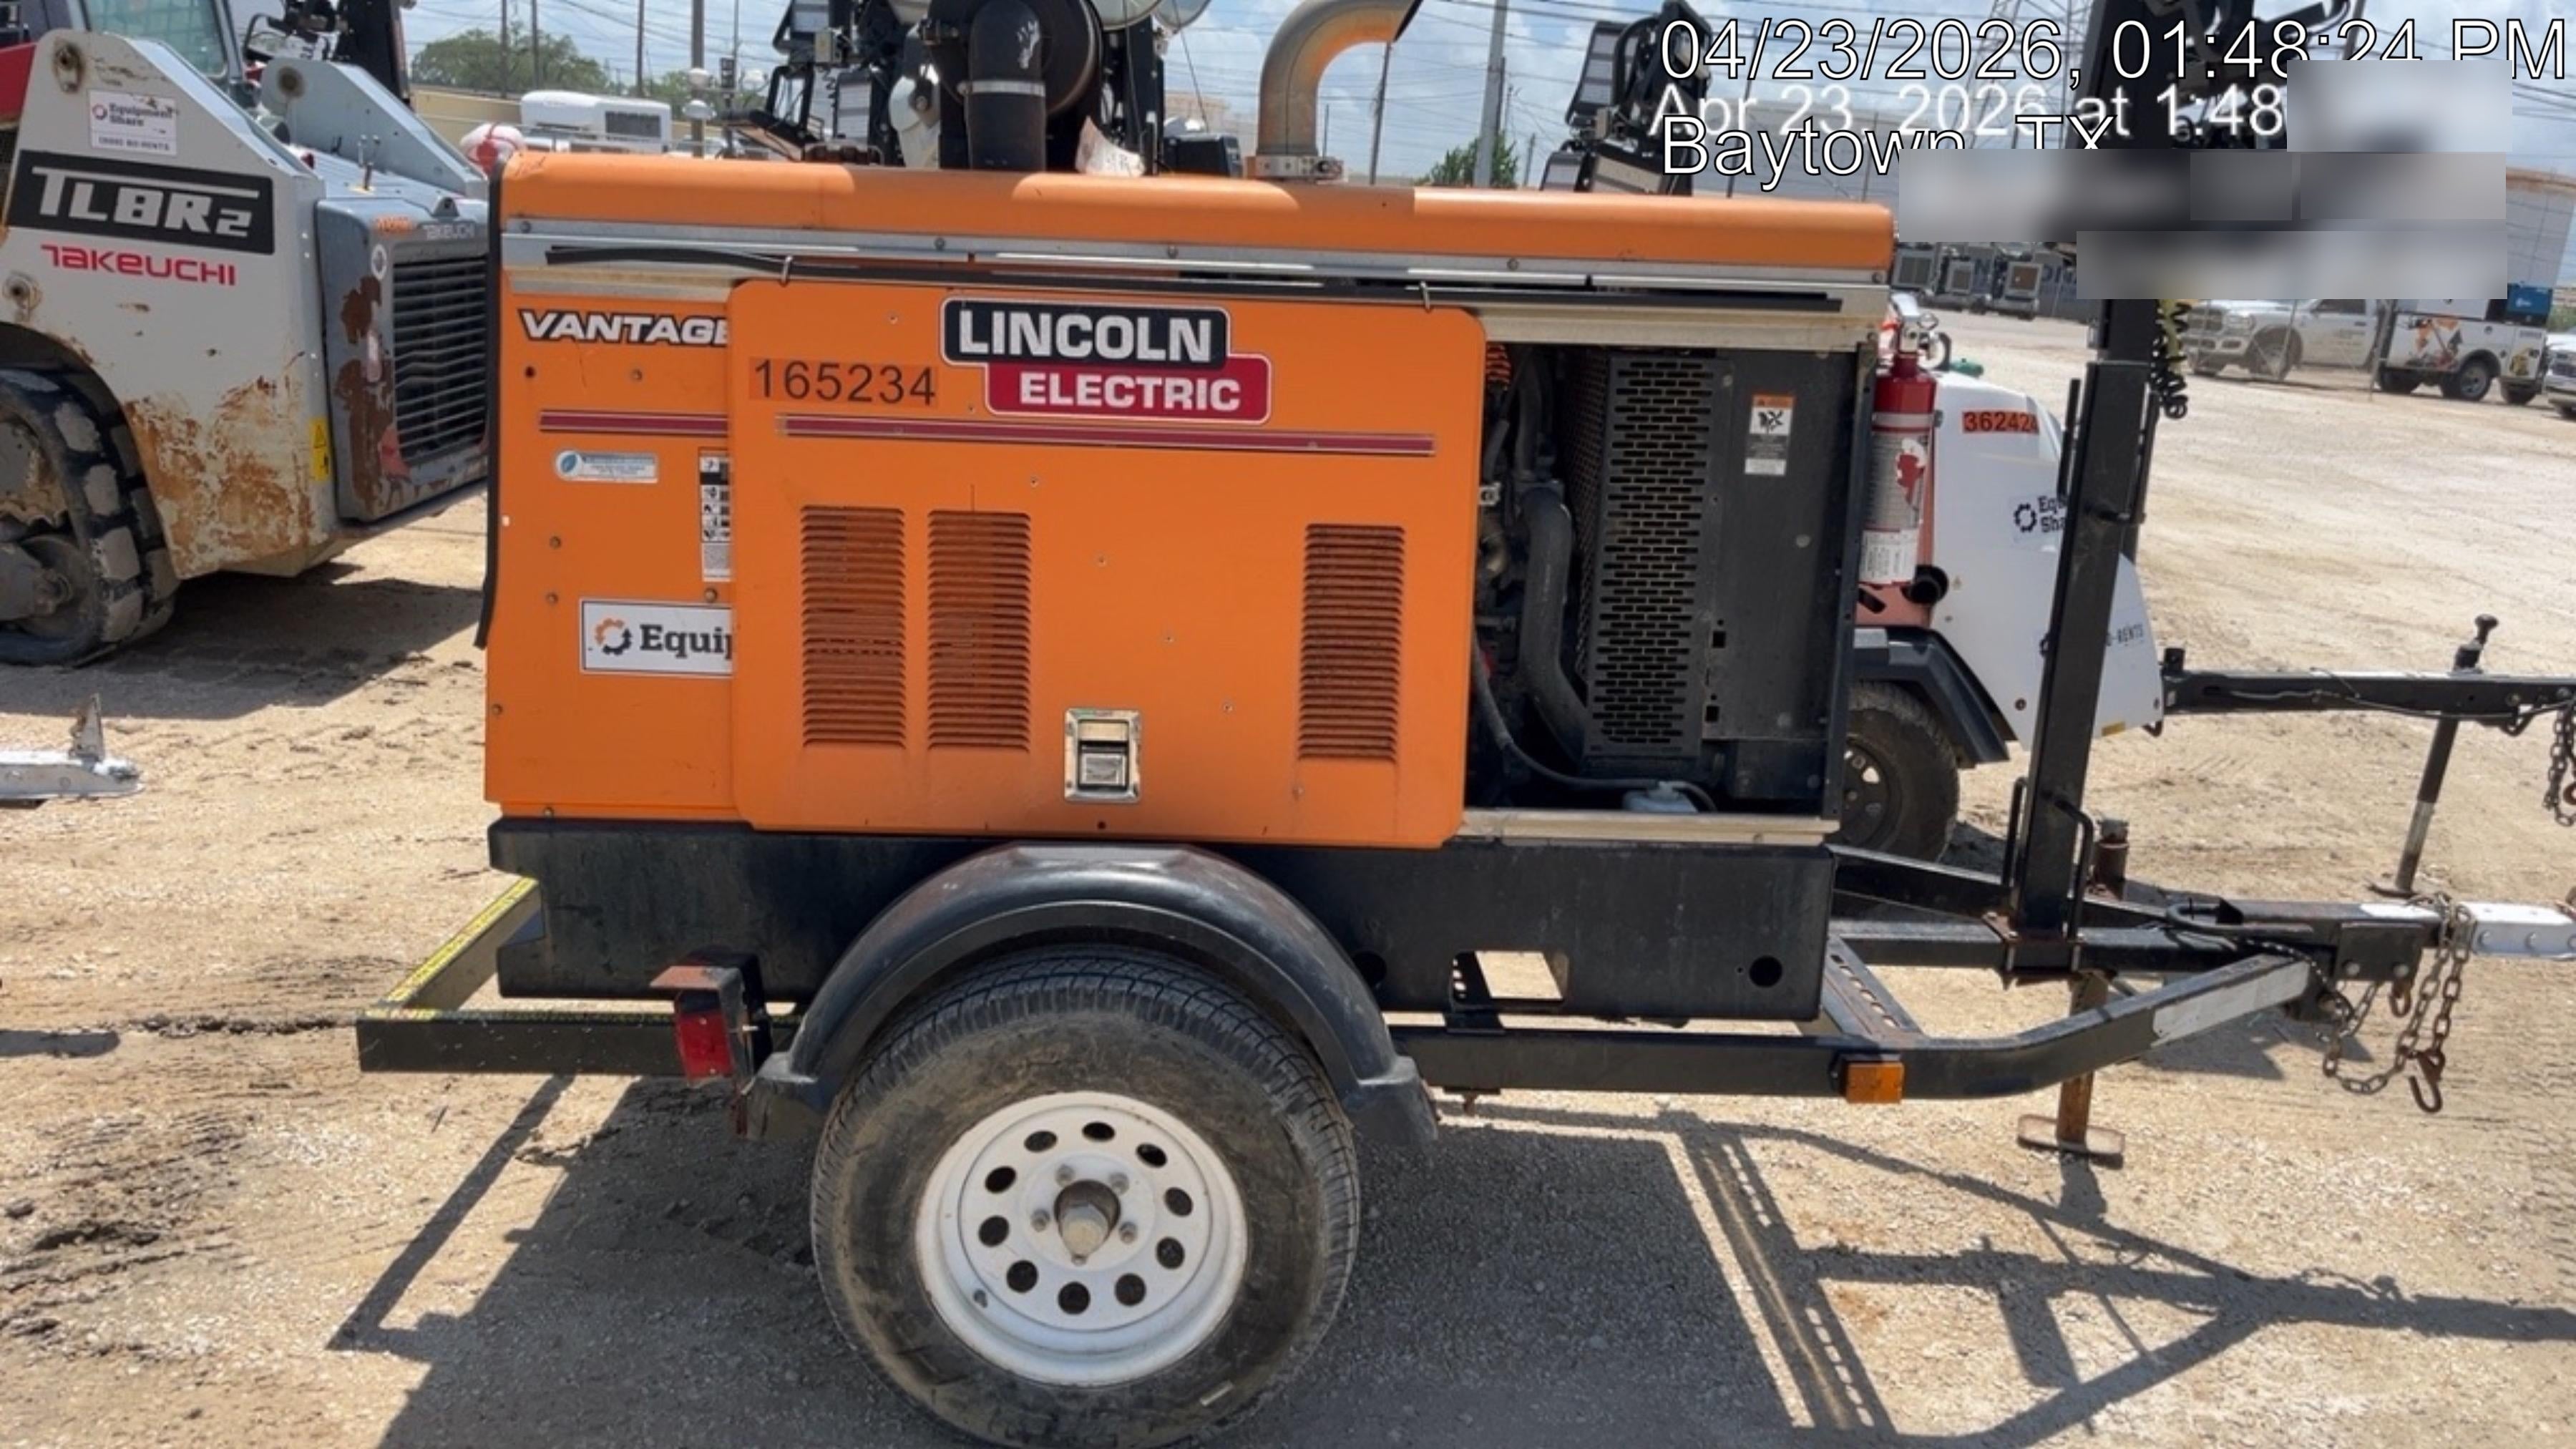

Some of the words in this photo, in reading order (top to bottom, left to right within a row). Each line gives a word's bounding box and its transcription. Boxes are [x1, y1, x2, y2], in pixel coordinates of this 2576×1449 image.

[958, 309, 1212, 364] LINCOLN
[753, 358, 936, 406] 165234
[1019, 371, 1241, 413] ELECTRIC
